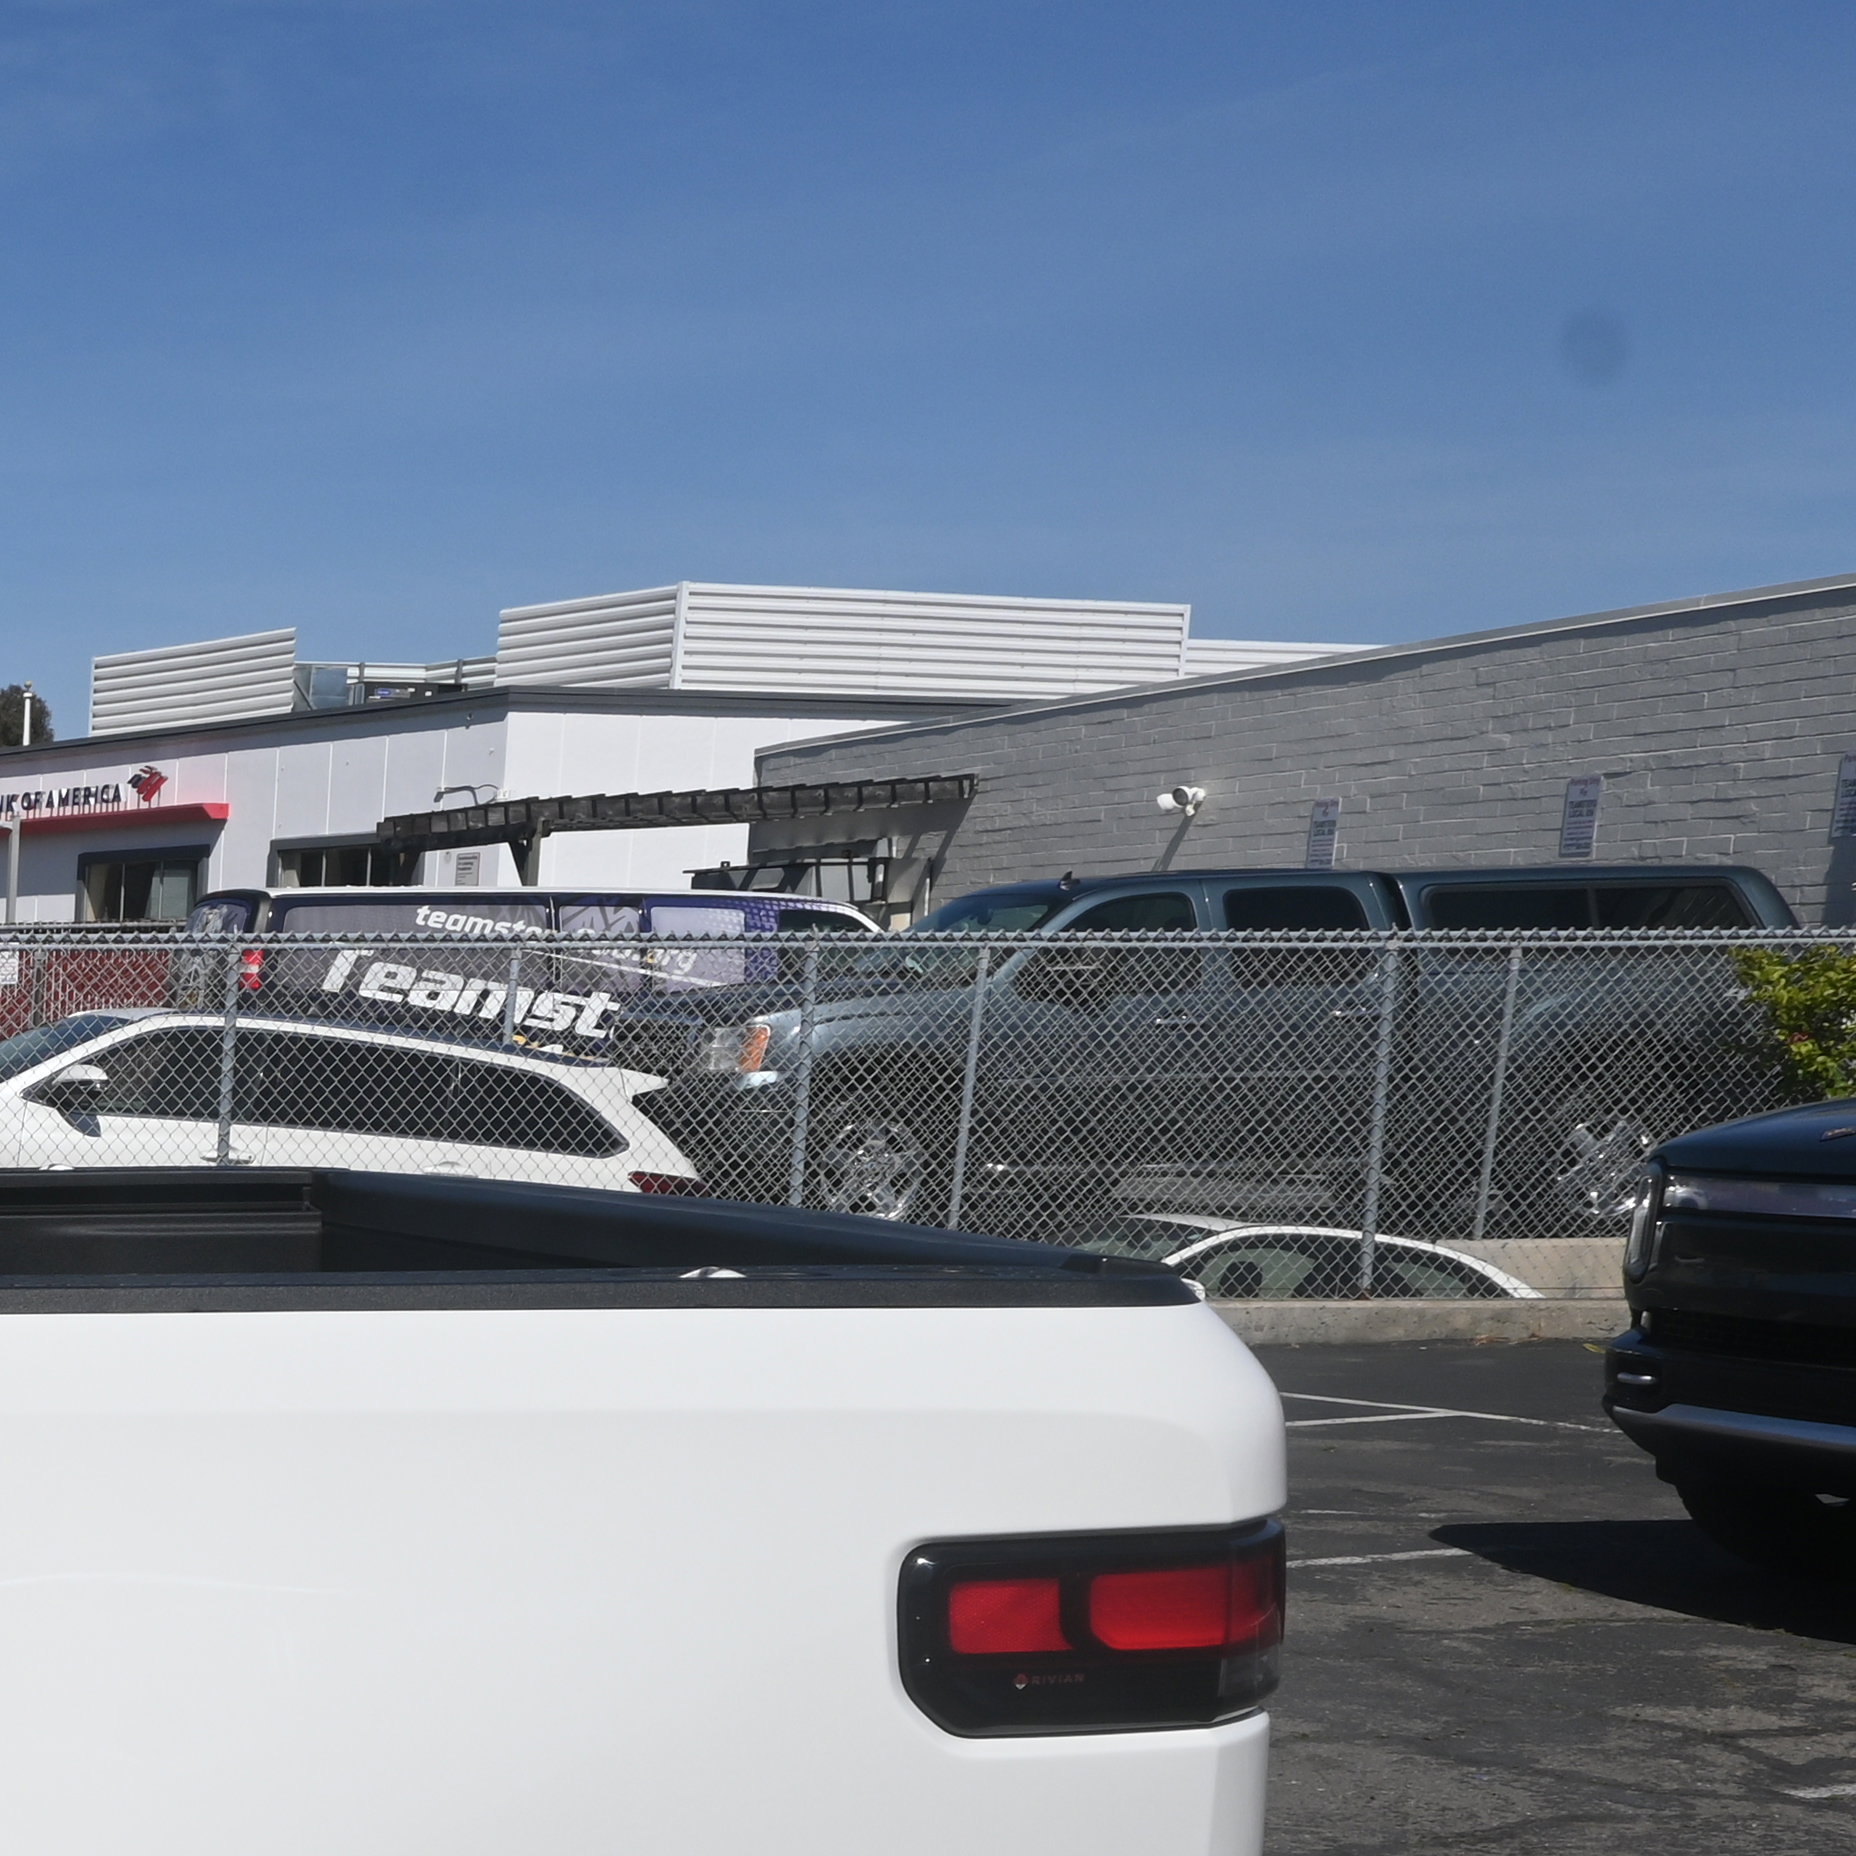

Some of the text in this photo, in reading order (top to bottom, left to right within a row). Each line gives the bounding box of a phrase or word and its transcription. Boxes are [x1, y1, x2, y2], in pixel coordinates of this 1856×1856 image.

[21, 791, 44, 811] OF
[45, 783, 122, 808] AMERICA
[322, 941, 621, 1039] Teamst
[1032, 1674, 1084, 1685] RIVIAN
